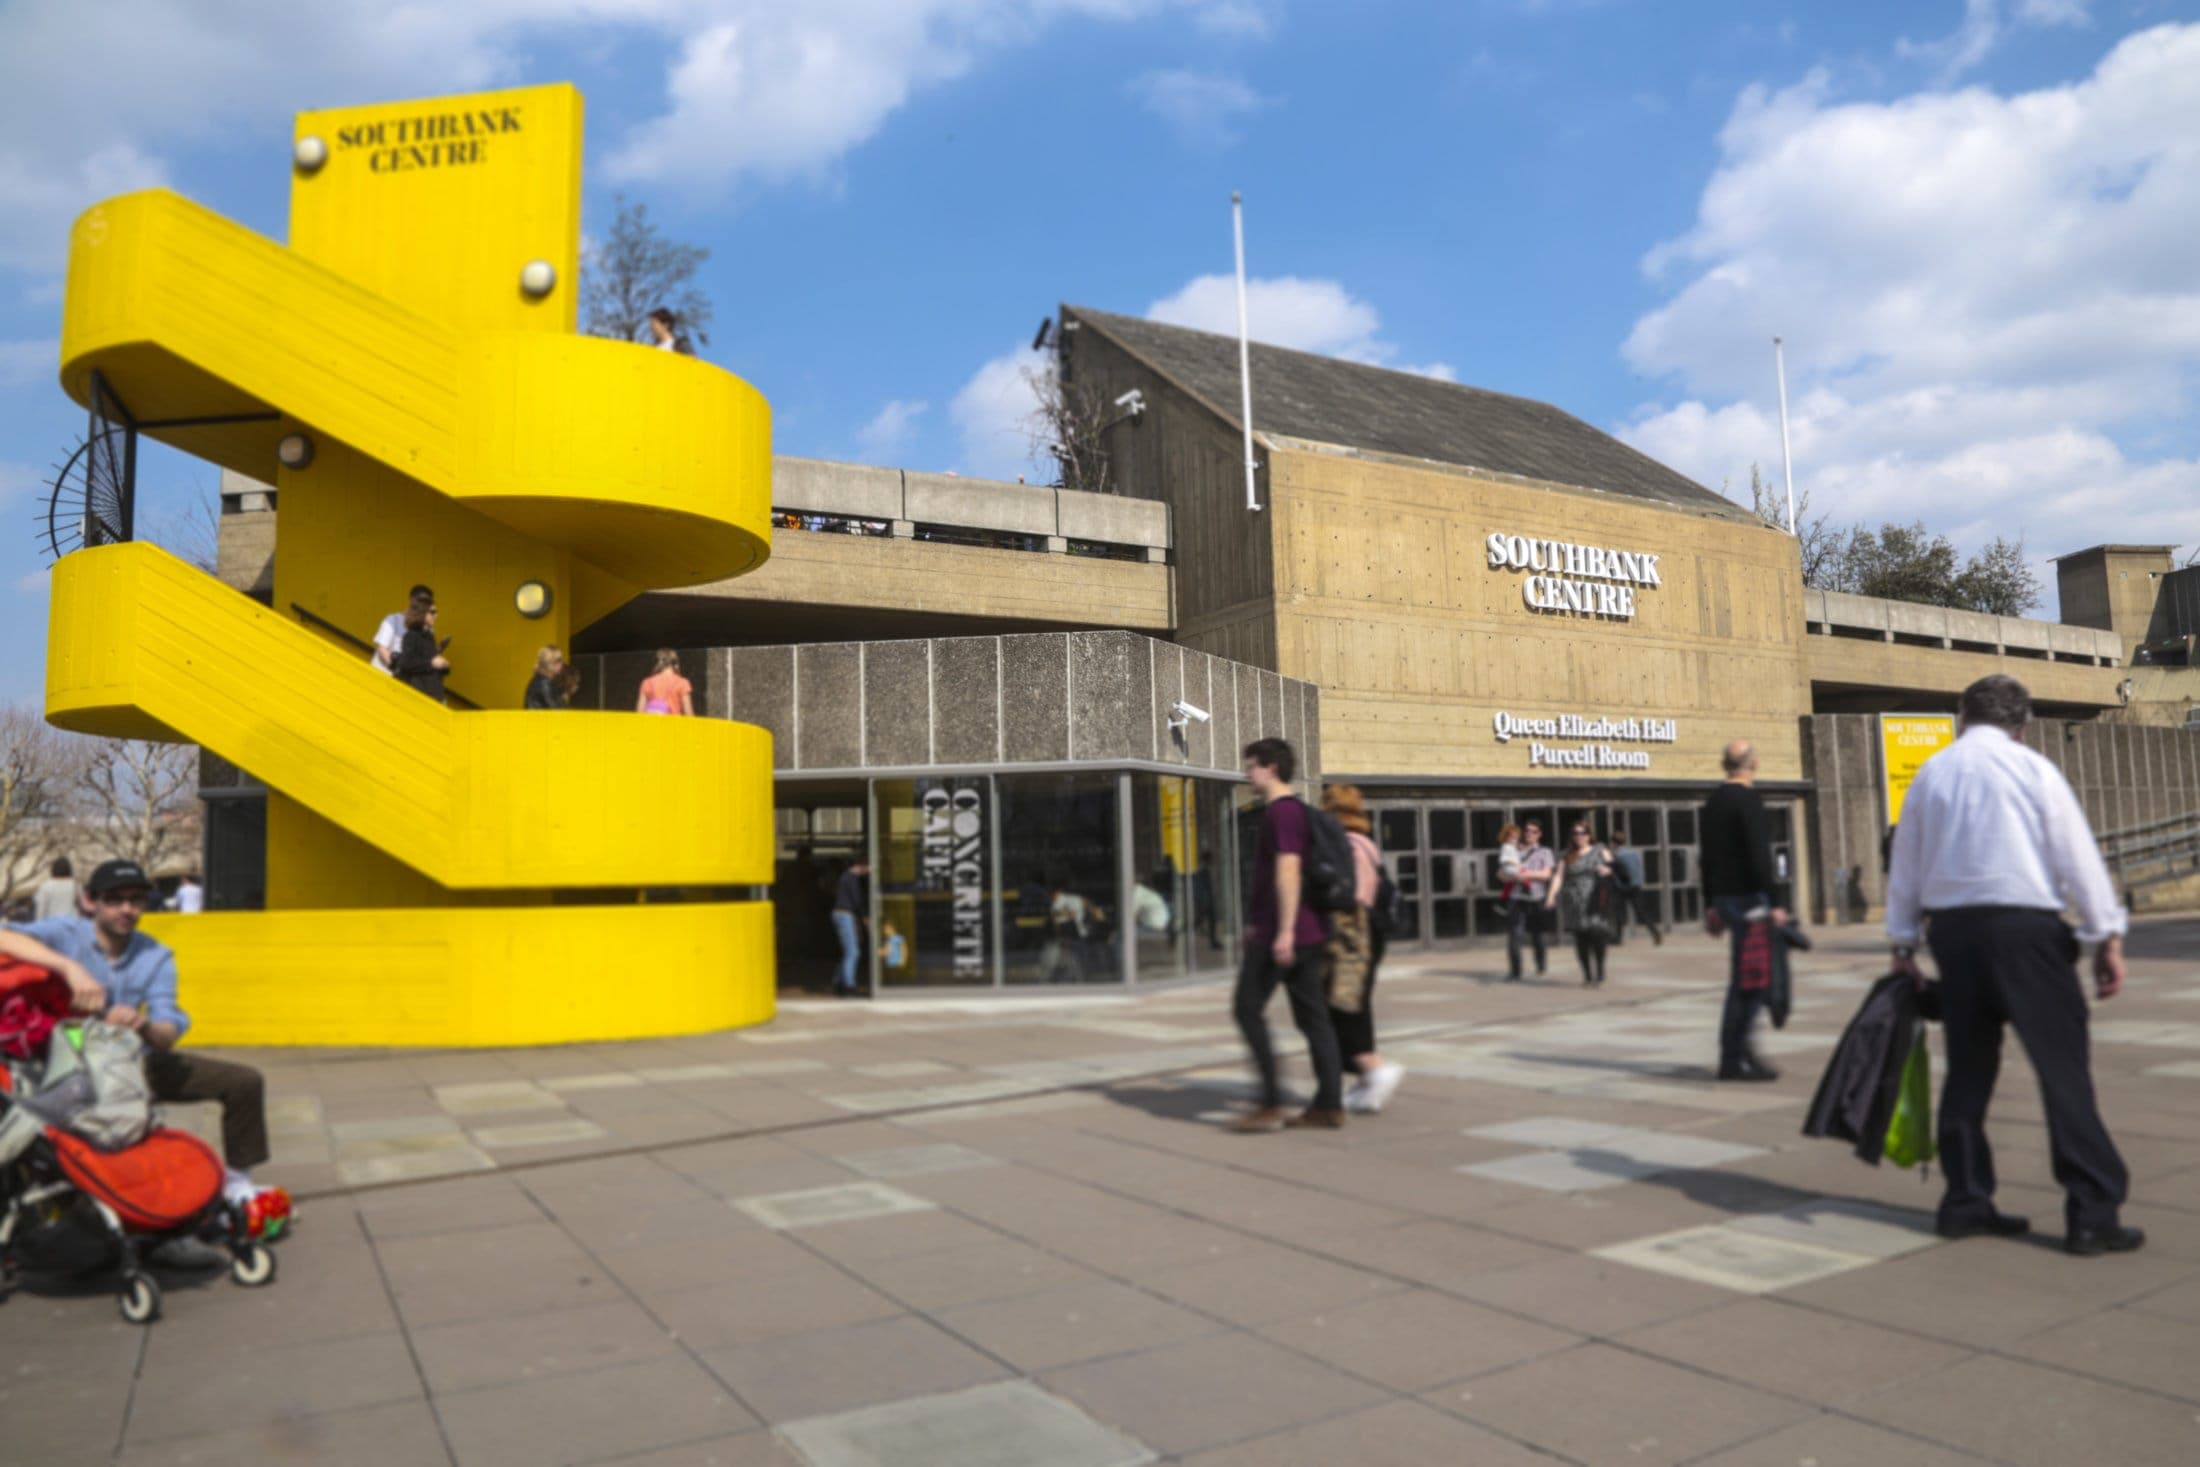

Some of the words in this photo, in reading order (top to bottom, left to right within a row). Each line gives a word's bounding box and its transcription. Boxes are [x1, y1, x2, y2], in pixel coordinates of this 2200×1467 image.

[337, 107, 522, 148] SOUTHBANK
[369, 140, 486, 173] CENTRE
[1486, 532, 1662, 586] SOUTHBANK
[1523, 574, 1636, 618] CENTRE
[1494, 710, 1557, 741] Queen
[1559, 713, 1640, 740] Elizabeth
[1642, 717, 1677, 742] Hall
[1530, 743, 1596, 766] Purcell
[1598, 746, 1649, 768] Room
